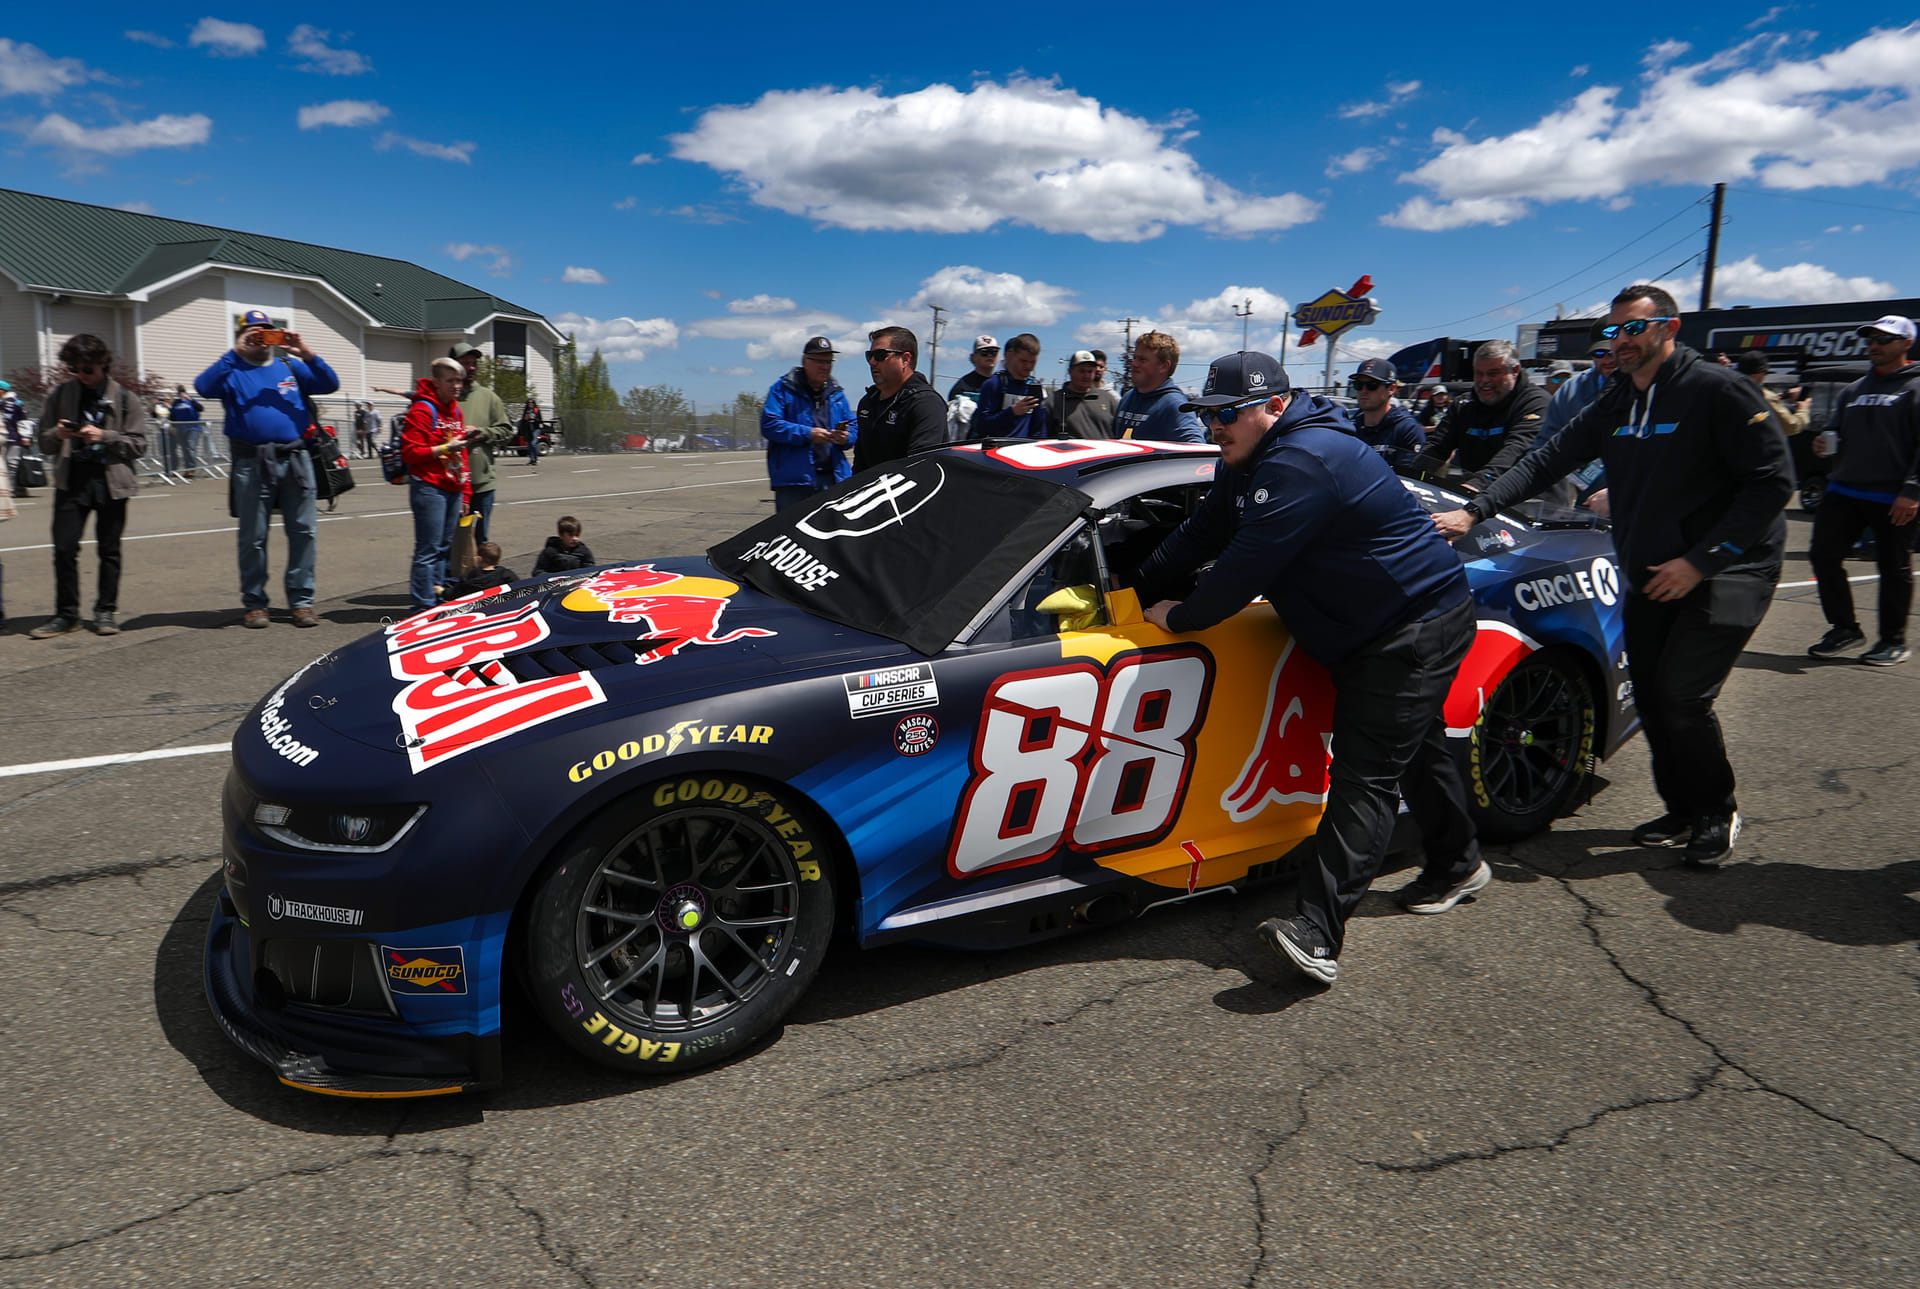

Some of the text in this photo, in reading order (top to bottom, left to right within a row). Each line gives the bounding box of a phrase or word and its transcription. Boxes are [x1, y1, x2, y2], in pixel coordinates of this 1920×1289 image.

[1300, 303, 1367, 322] SUNOCO
[1514, 571, 1595, 611] CIRCLE
[874, 667, 920, 686] NASCAR
[387, 610, 609, 775] Bull
[862, 686, 926, 707] CUP SERIES
[899, 716, 933, 733] NASCAR
[907, 729, 928, 741] 250
[568, 724, 774, 783] GOODYEAR
[899, 736, 935, 754] SALUTES
[947, 647, 1211, 878] 88
[653, 779, 822, 882] GOODYEAR
[288, 902, 350, 923] TRACKHOUSE
[391, 965, 459, 979] SUNOCO
[581, 1011, 681, 1063] EAGLE
